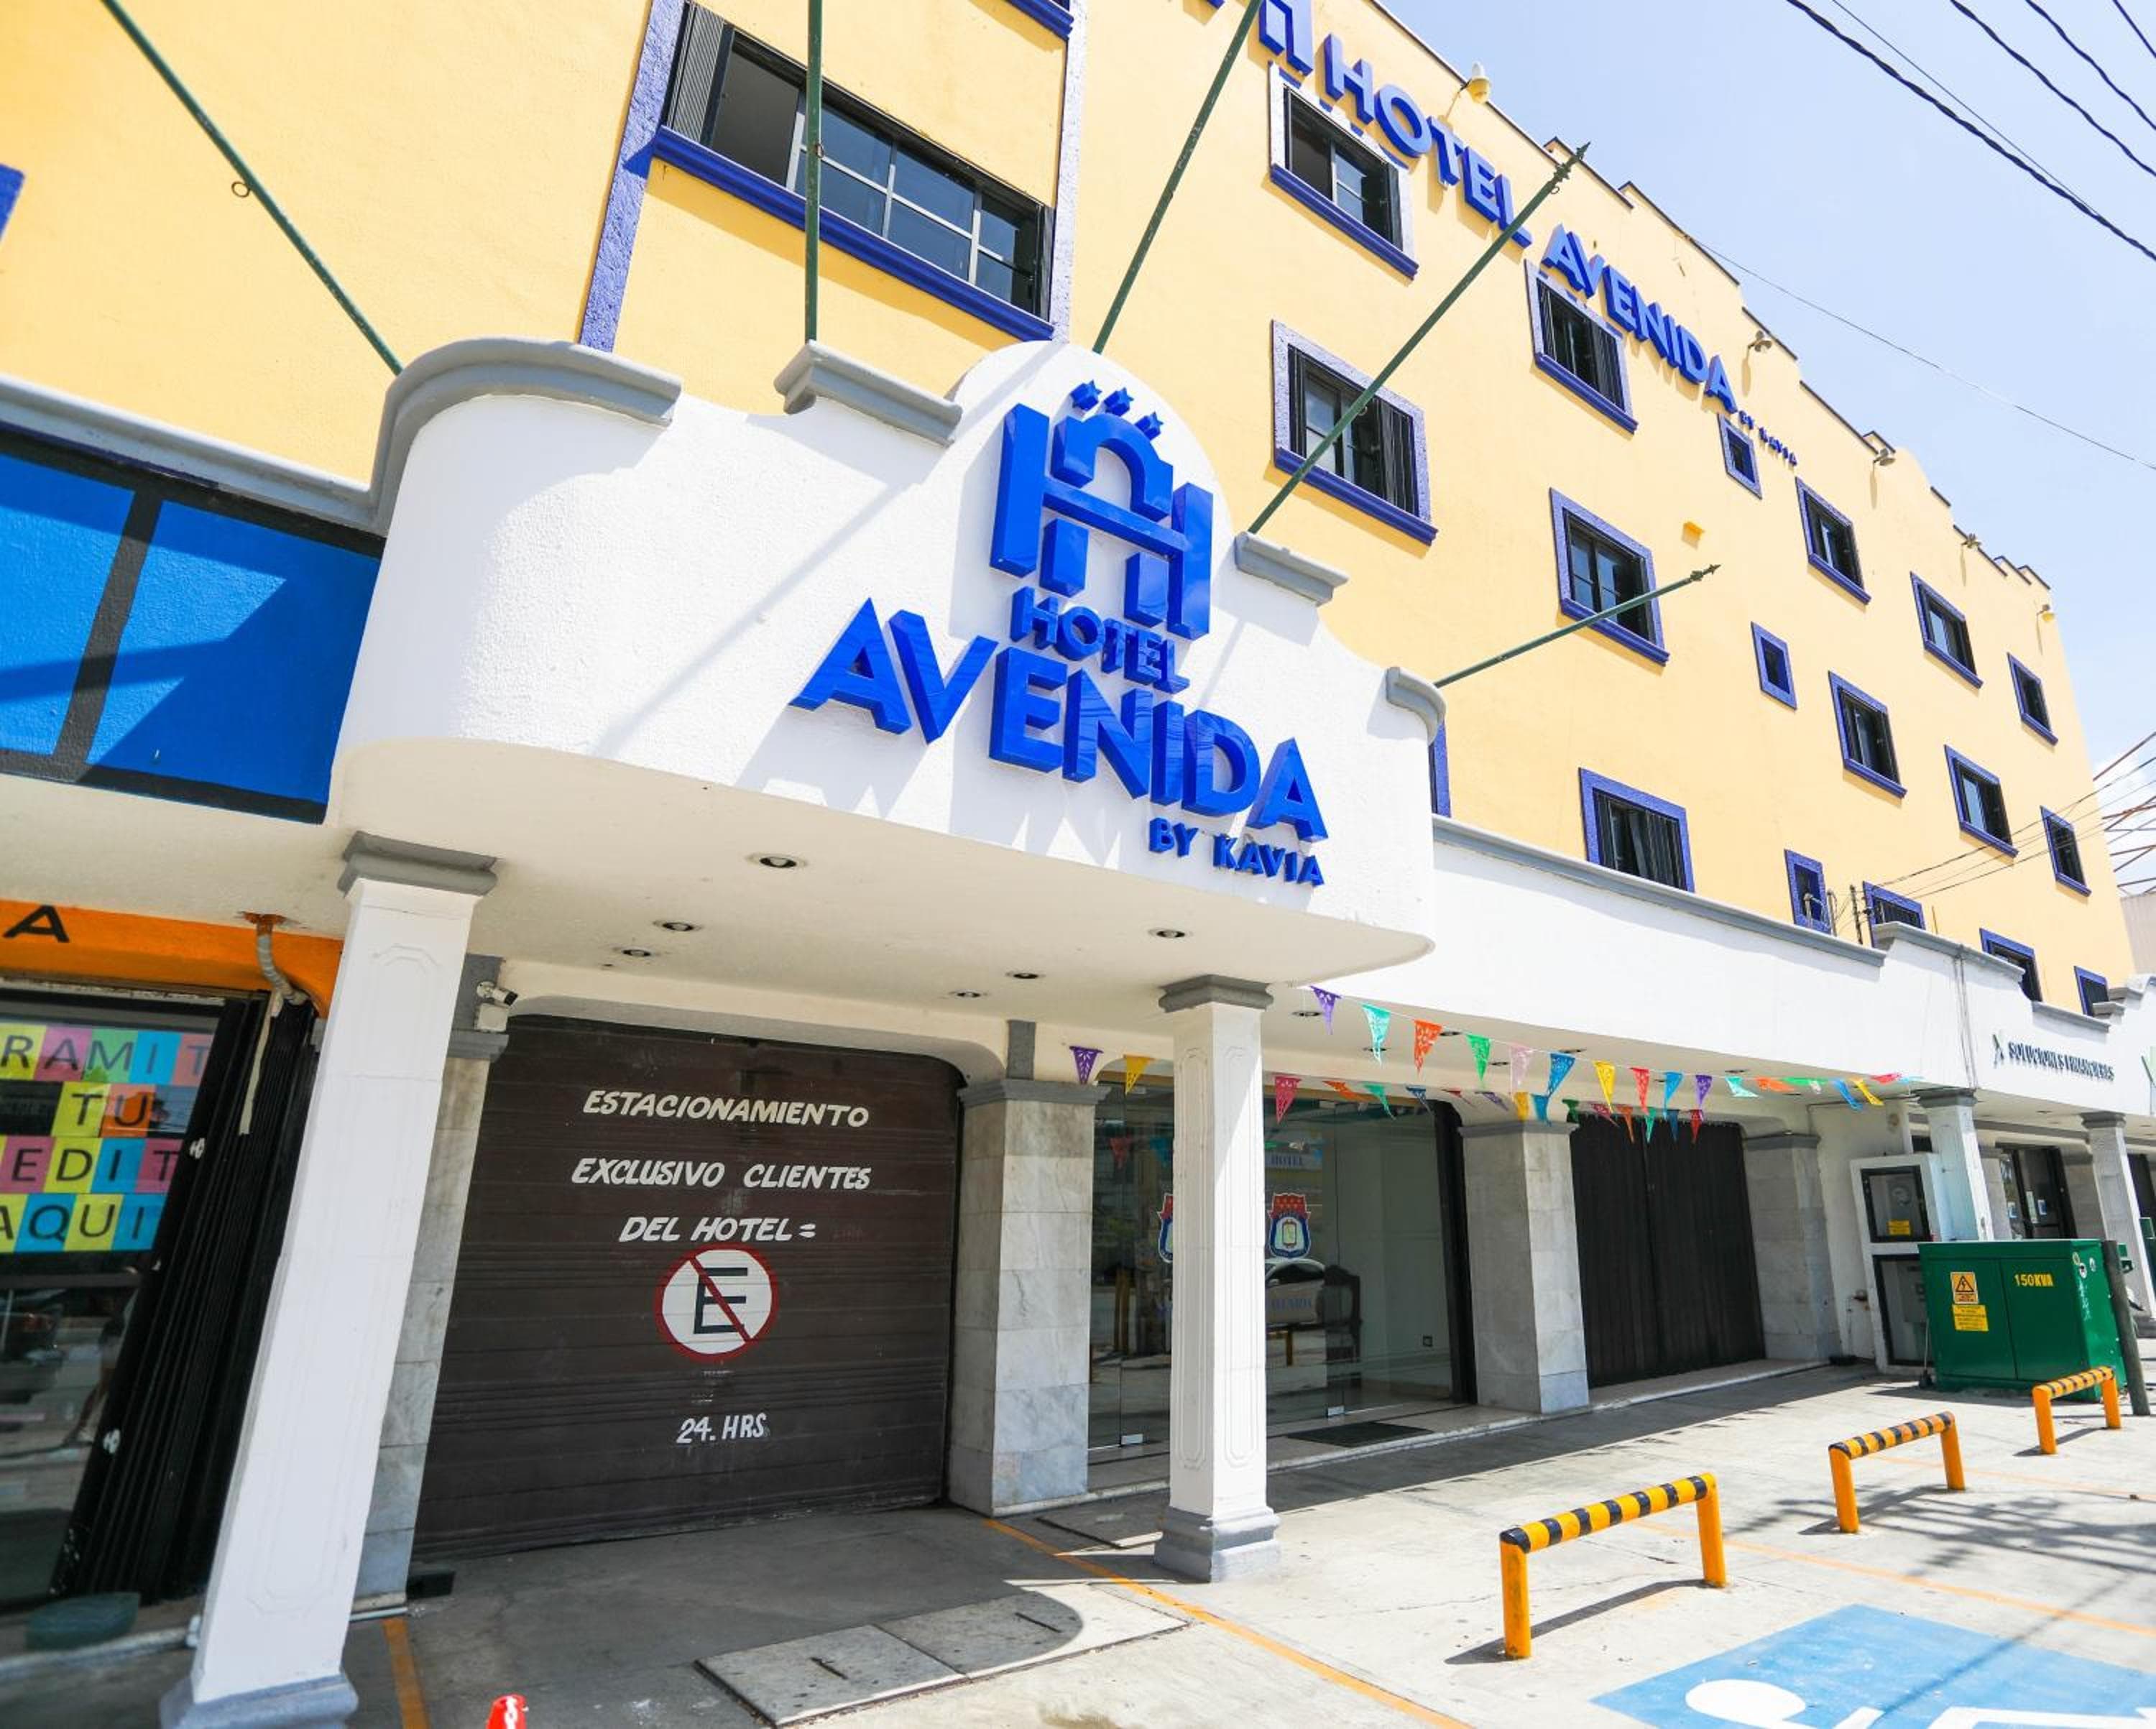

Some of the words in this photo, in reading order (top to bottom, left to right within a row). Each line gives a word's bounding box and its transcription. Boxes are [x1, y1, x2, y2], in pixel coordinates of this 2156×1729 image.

[1322, 33, 1531, 248] HOTEL
[1542, 224, 1738, 415] AVENIDA
[1010, 586, 1189, 694] HOTEL
[789, 598, 1329, 843] AVENIDA
[1149, 817, 1199, 857] BY
[1212, 833, 1325, 887] KAVIA
[3, 904, 70, 943] A
[70, 1094, 148, 1128] TU
[583, 1090, 870, 1127] ESTACIONAMIENTO
[11, 1148, 179, 1182] EDIT
[571, 1158, 725, 1188] EXCLUSIVO
[743, 1164, 871, 1189] CLIENTES
[619, 1217, 681, 1242] DEL
[691, 1218, 793, 1242] HOTEL
[2014, 1273, 2054, 1287] 150KVA
[722, 1411, 768, 1440] HRS
